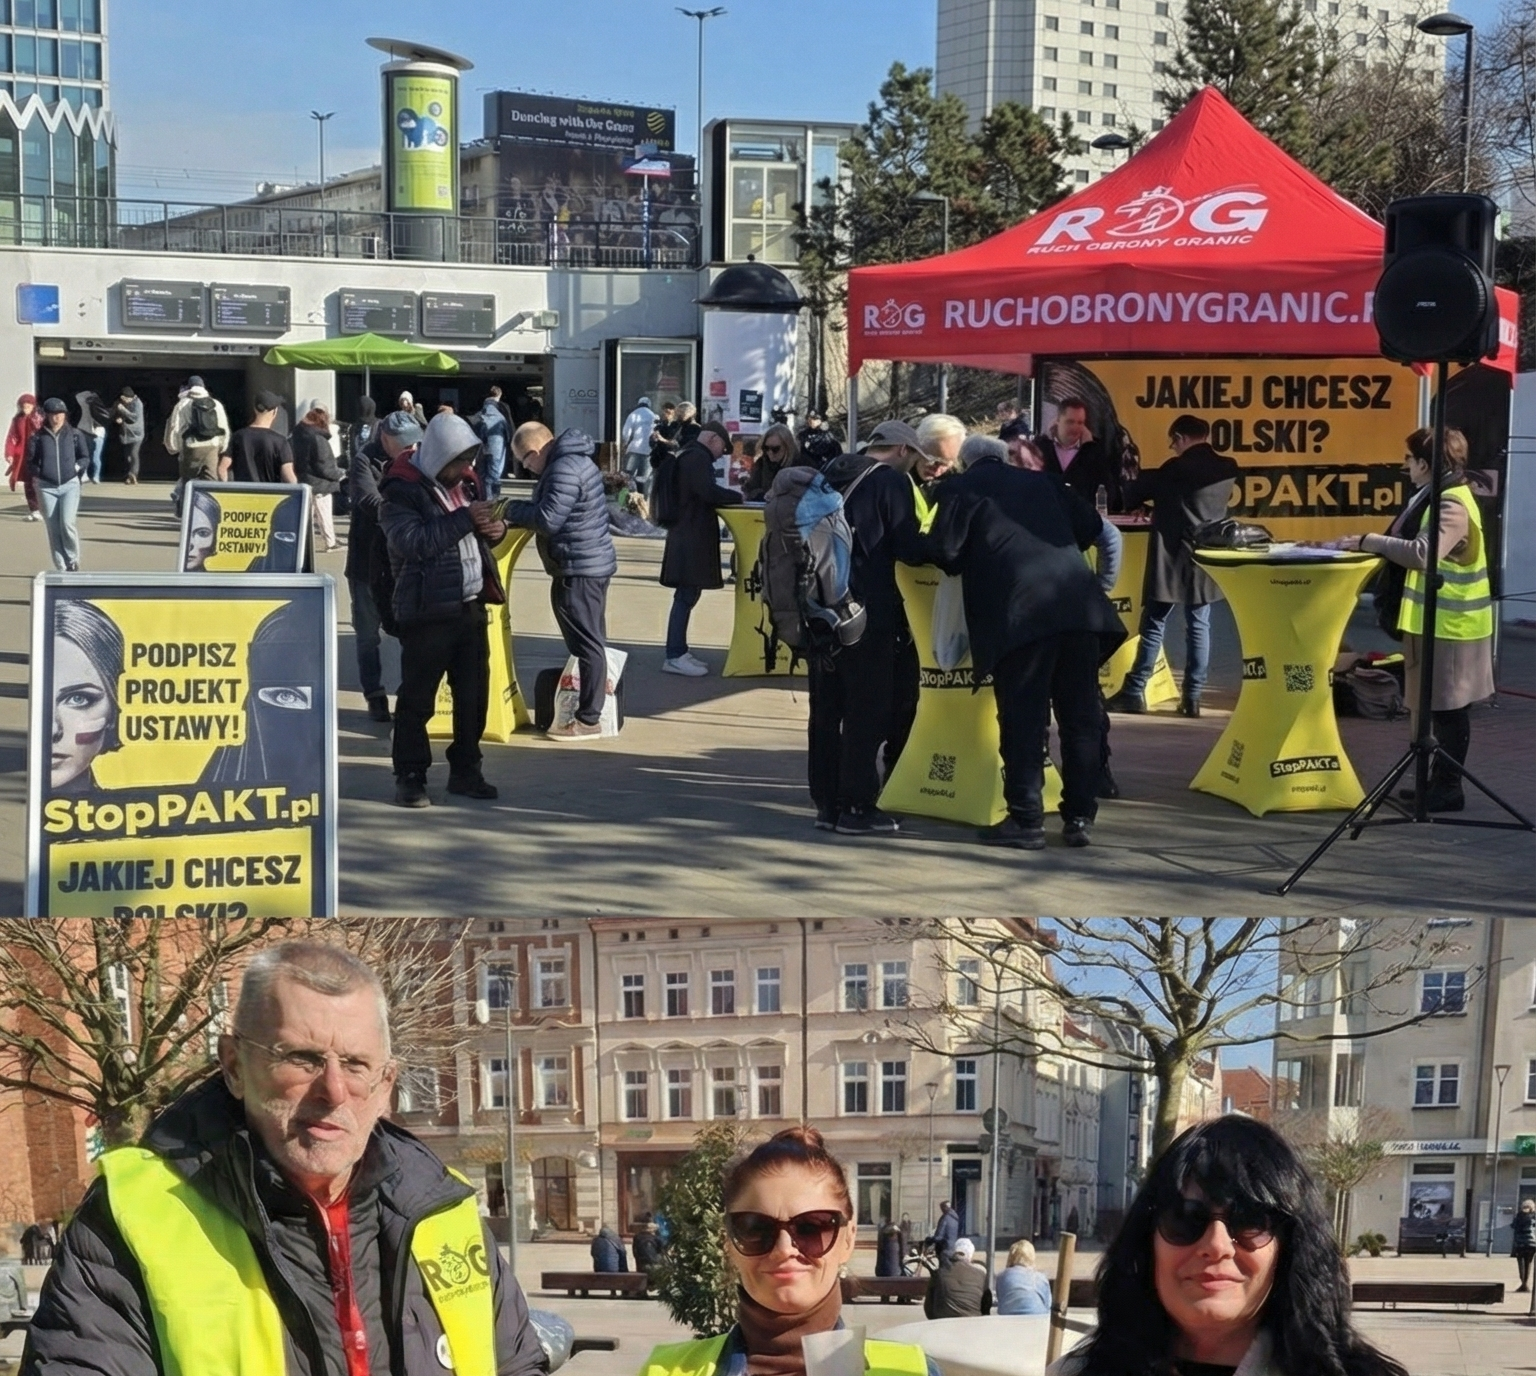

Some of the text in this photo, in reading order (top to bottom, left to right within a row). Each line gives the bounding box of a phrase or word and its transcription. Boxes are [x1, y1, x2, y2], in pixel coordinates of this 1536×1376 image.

[1085, 237, 1171, 251] OBRONY
[1173, 234, 1254, 247] GRANIC
[1135, 375, 1393, 409] JAKIEJ CHCESZ
[1209, 419, 1331, 454] OLSKI?
[131, 642, 237, 668] PODPISZ
[125, 678, 242, 705] PROJEKT
[126, 714, 240, 741] USTAWY!
[43, 786, 320, 836] StopPAKT.pl
[57, 854, 302, 893] JAKIEJ CHCESZ
